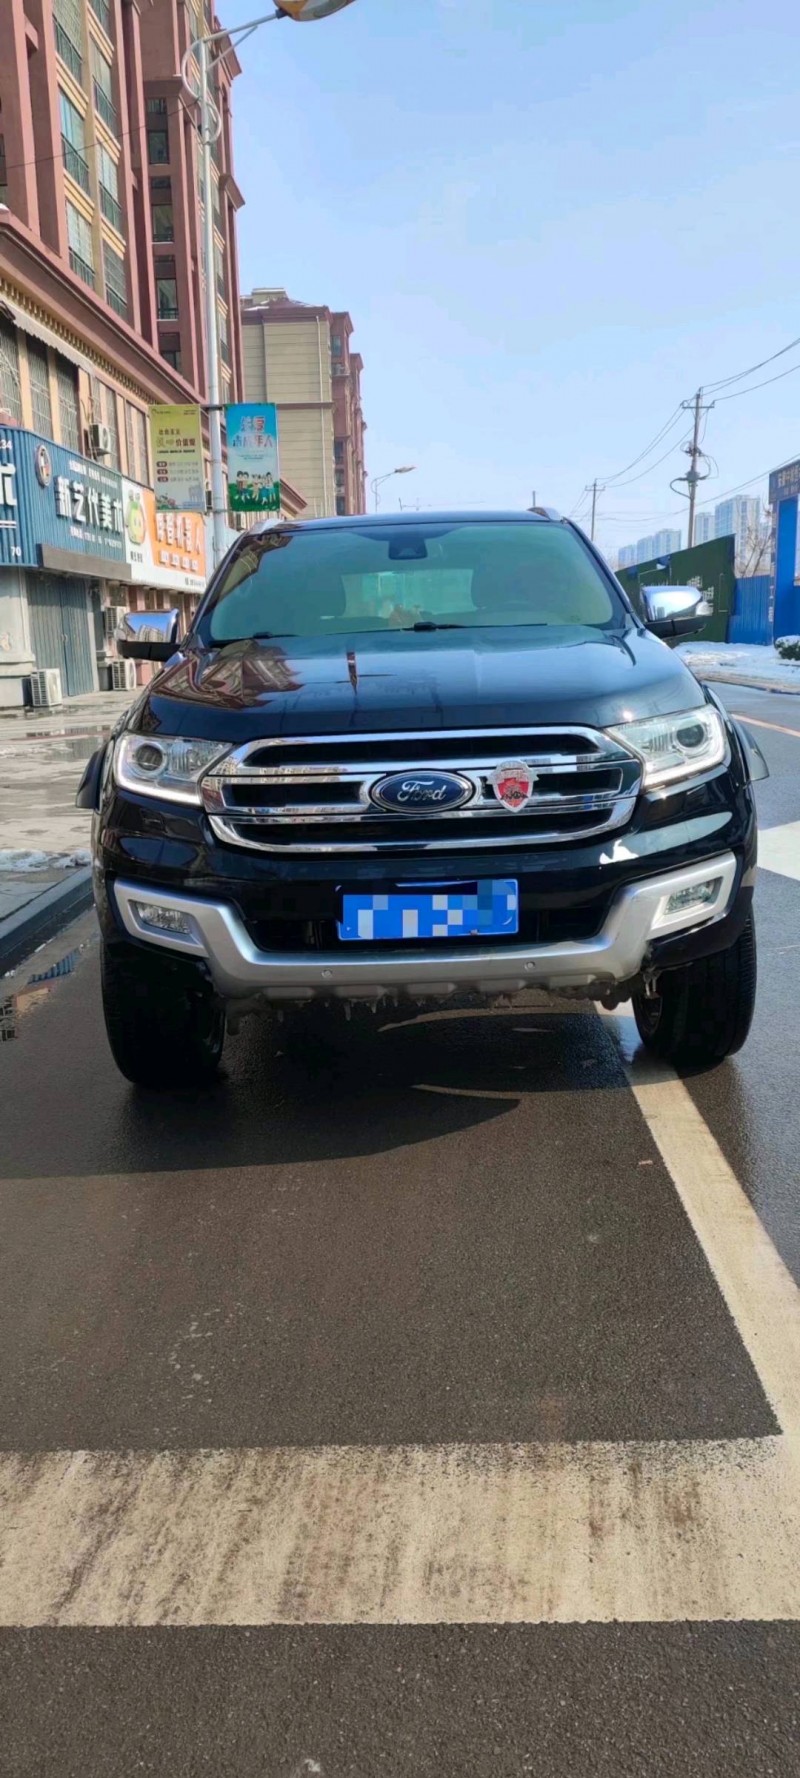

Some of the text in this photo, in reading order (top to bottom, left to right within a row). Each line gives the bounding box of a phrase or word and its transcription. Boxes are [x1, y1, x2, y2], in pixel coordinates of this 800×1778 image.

[57, 476, 123, 533] 新艺代美术
[397, 780, 447, 802] Ford
